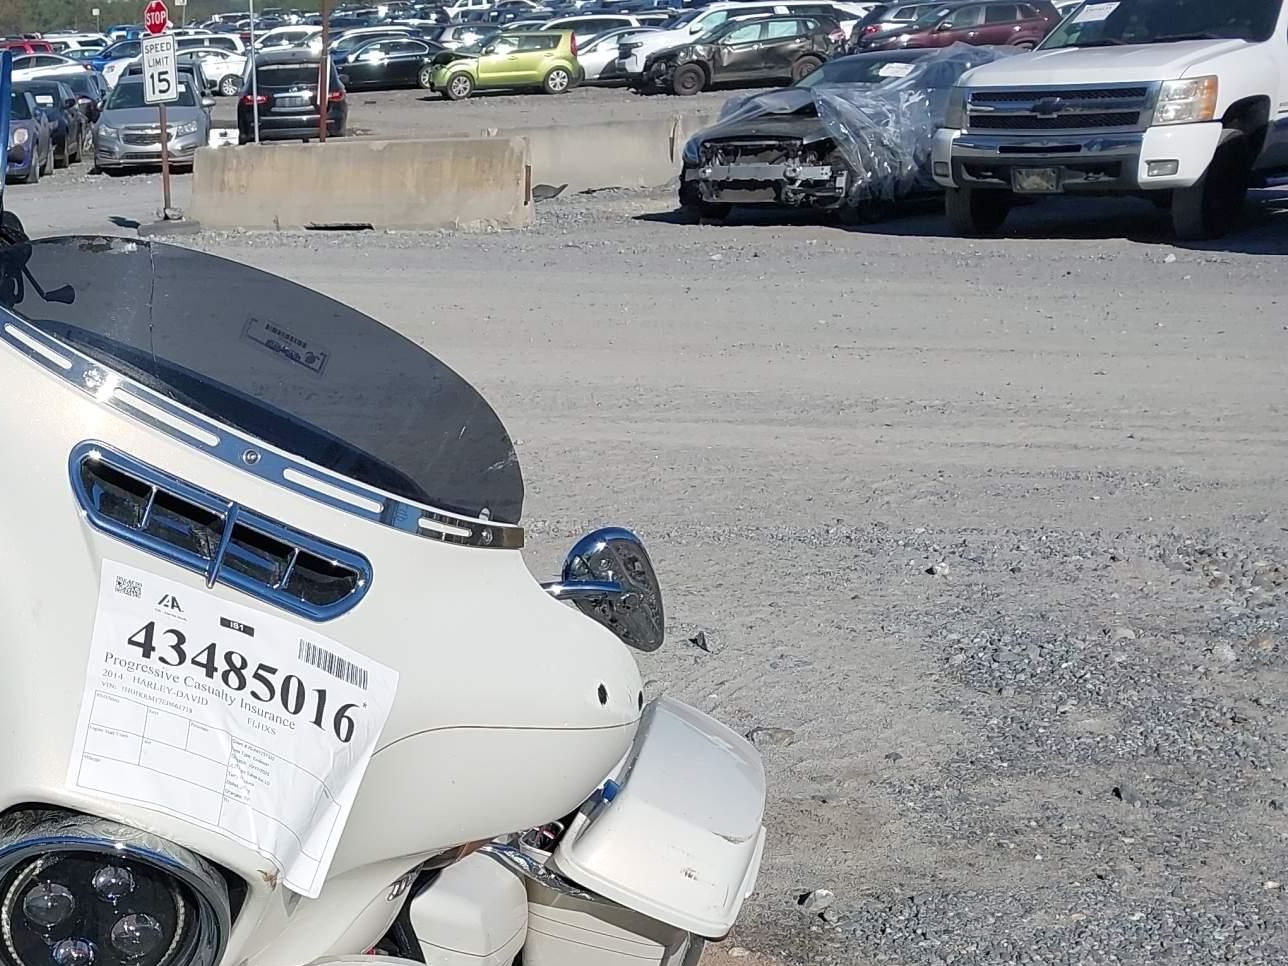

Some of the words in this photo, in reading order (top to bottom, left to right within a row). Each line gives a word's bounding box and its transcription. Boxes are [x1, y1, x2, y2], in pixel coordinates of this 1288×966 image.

[146, 11, 166, 25] STOP
[145, 42, 172, 54] SPEED
[148, 57, 169, 67] LIMIT
[150, 71, 170, 95] 15
[101, 669, 123, 681] 2014
[132, 676, 209, 706] HARLEY-DAVID
[104, 651, 180, 684] Progressive
[183, 675, 236, 706] Casualty
[240, 697, 296, 730] Insurance
[127, 621, 360, 743] 43485016
